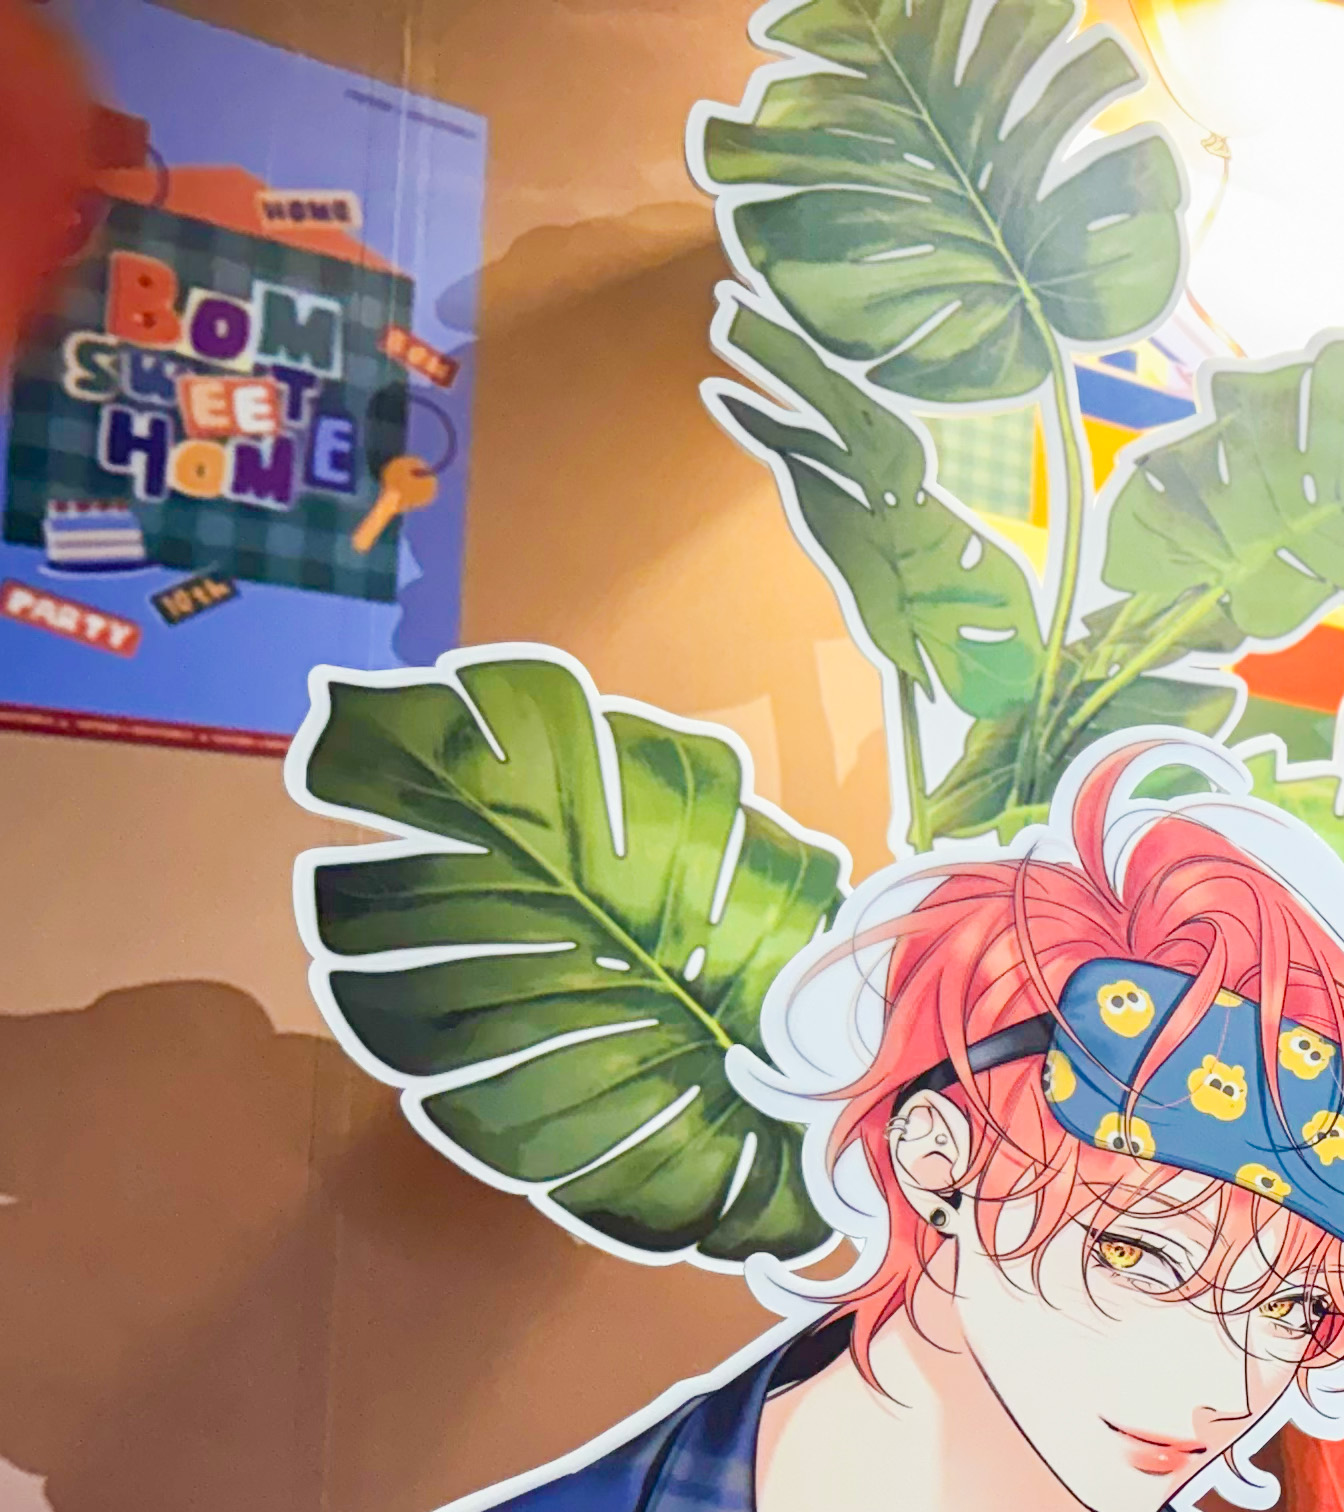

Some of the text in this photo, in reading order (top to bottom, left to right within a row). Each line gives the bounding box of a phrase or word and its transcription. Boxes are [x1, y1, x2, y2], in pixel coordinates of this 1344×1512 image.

[108, 252, 340, 376] BOM
[66, 332, 318, 436] SWEET
[104, 408, 354, 504] HOME
[7, 587, 133, 649] PARTY
